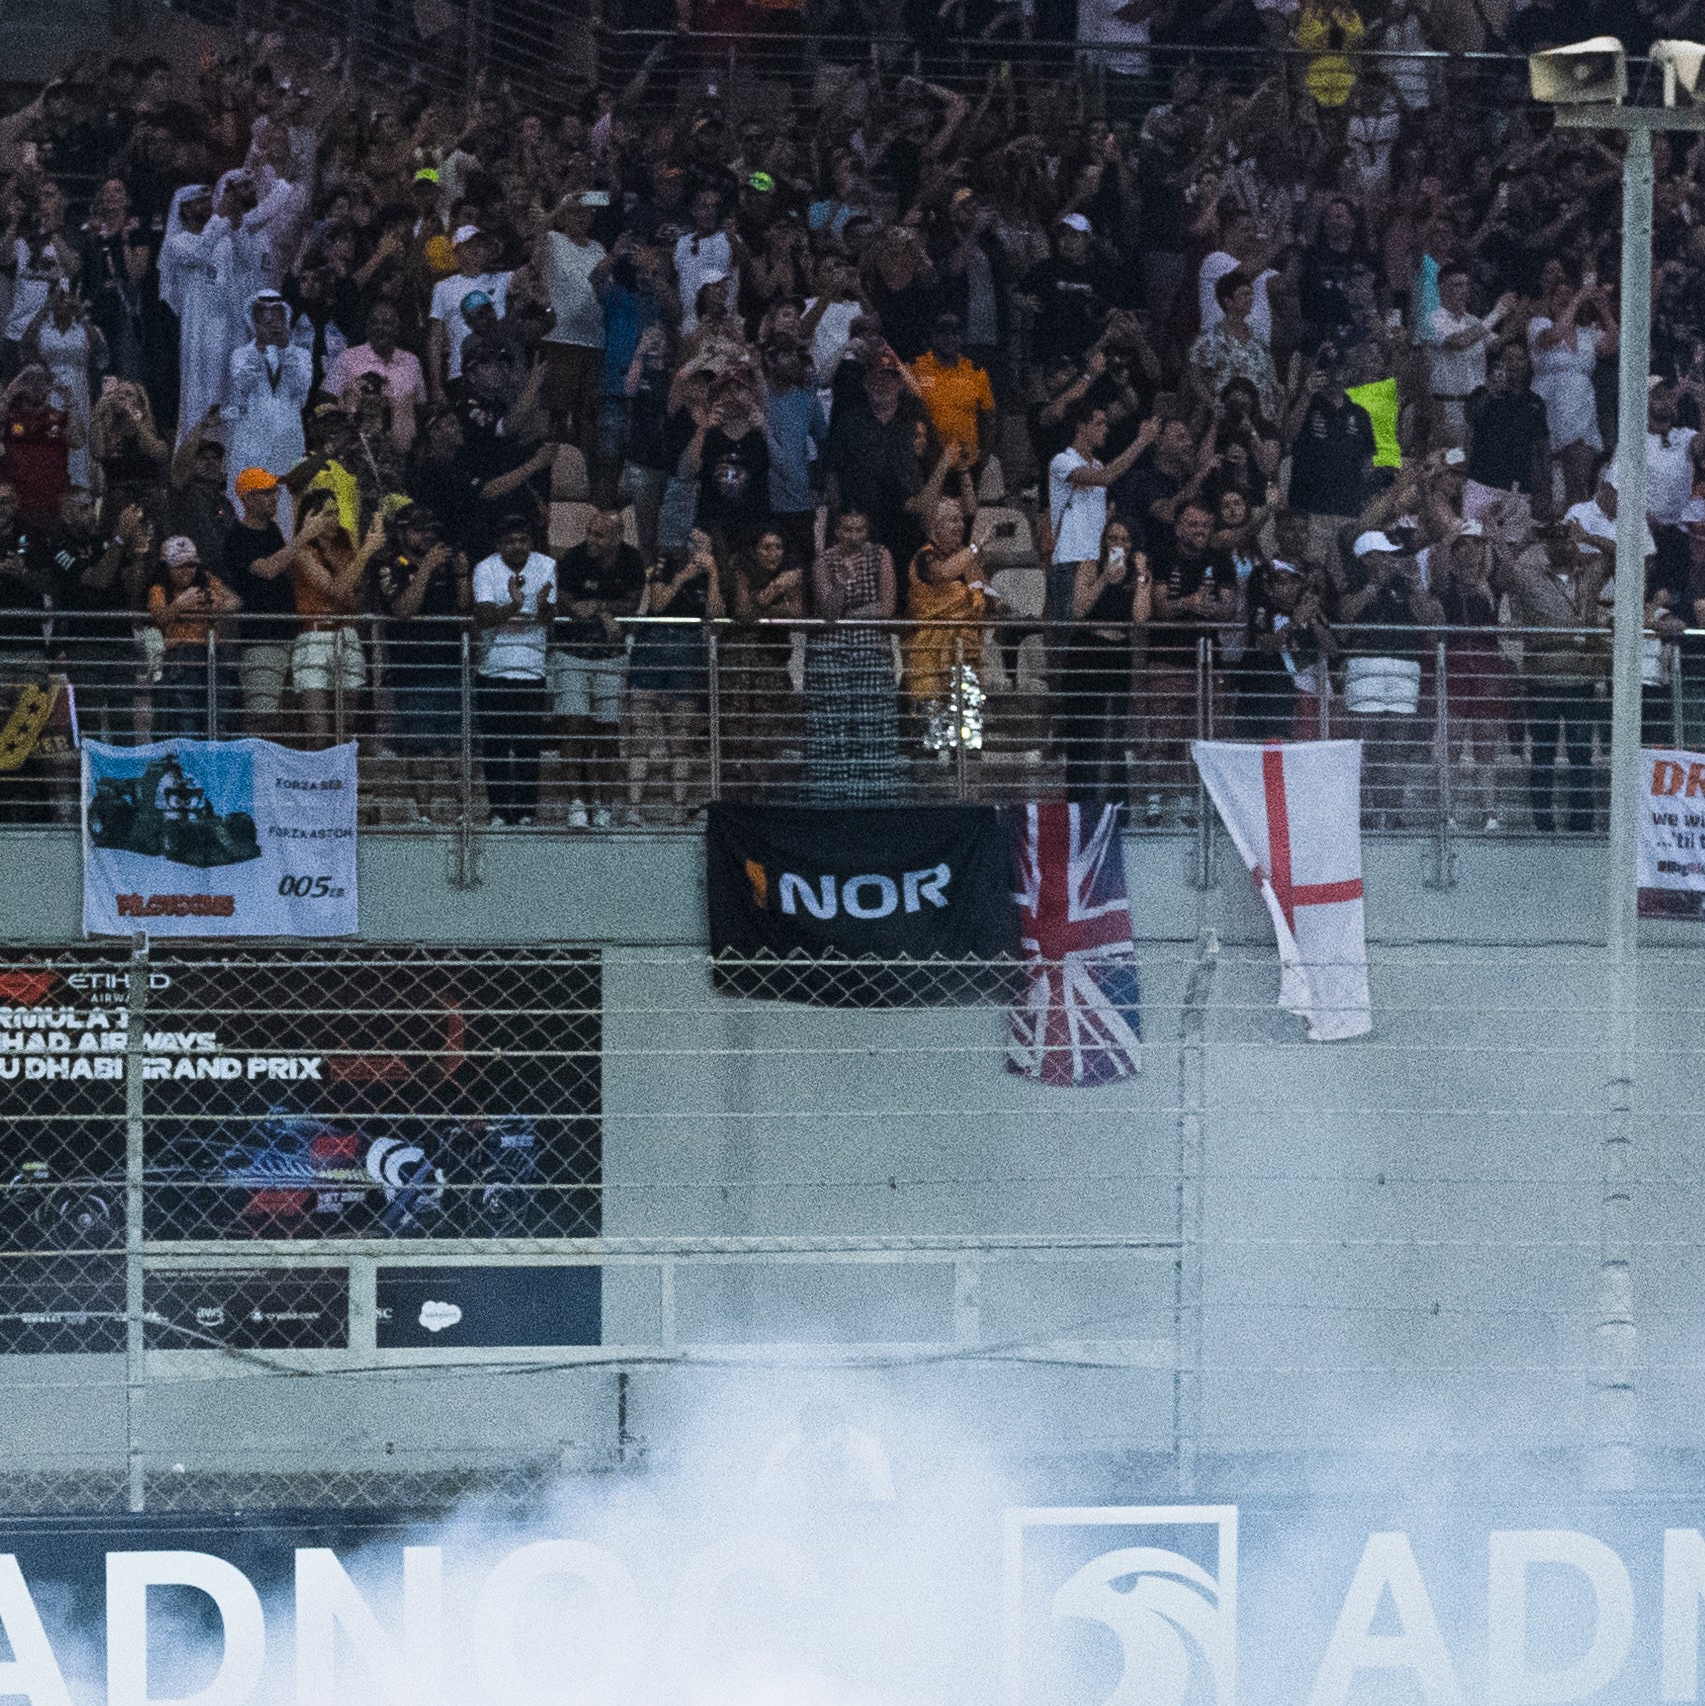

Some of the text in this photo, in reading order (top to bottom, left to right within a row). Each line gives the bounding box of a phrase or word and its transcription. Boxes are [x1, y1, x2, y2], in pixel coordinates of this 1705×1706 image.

[1651, 811, 1679, 827] we
[779, 862, 951, 920] NOR
[67, 972, 172, 989] ETIHD
[25, 1057, 124, 1080] DHABI
[247, 1057, 323, 1080] PRIX
